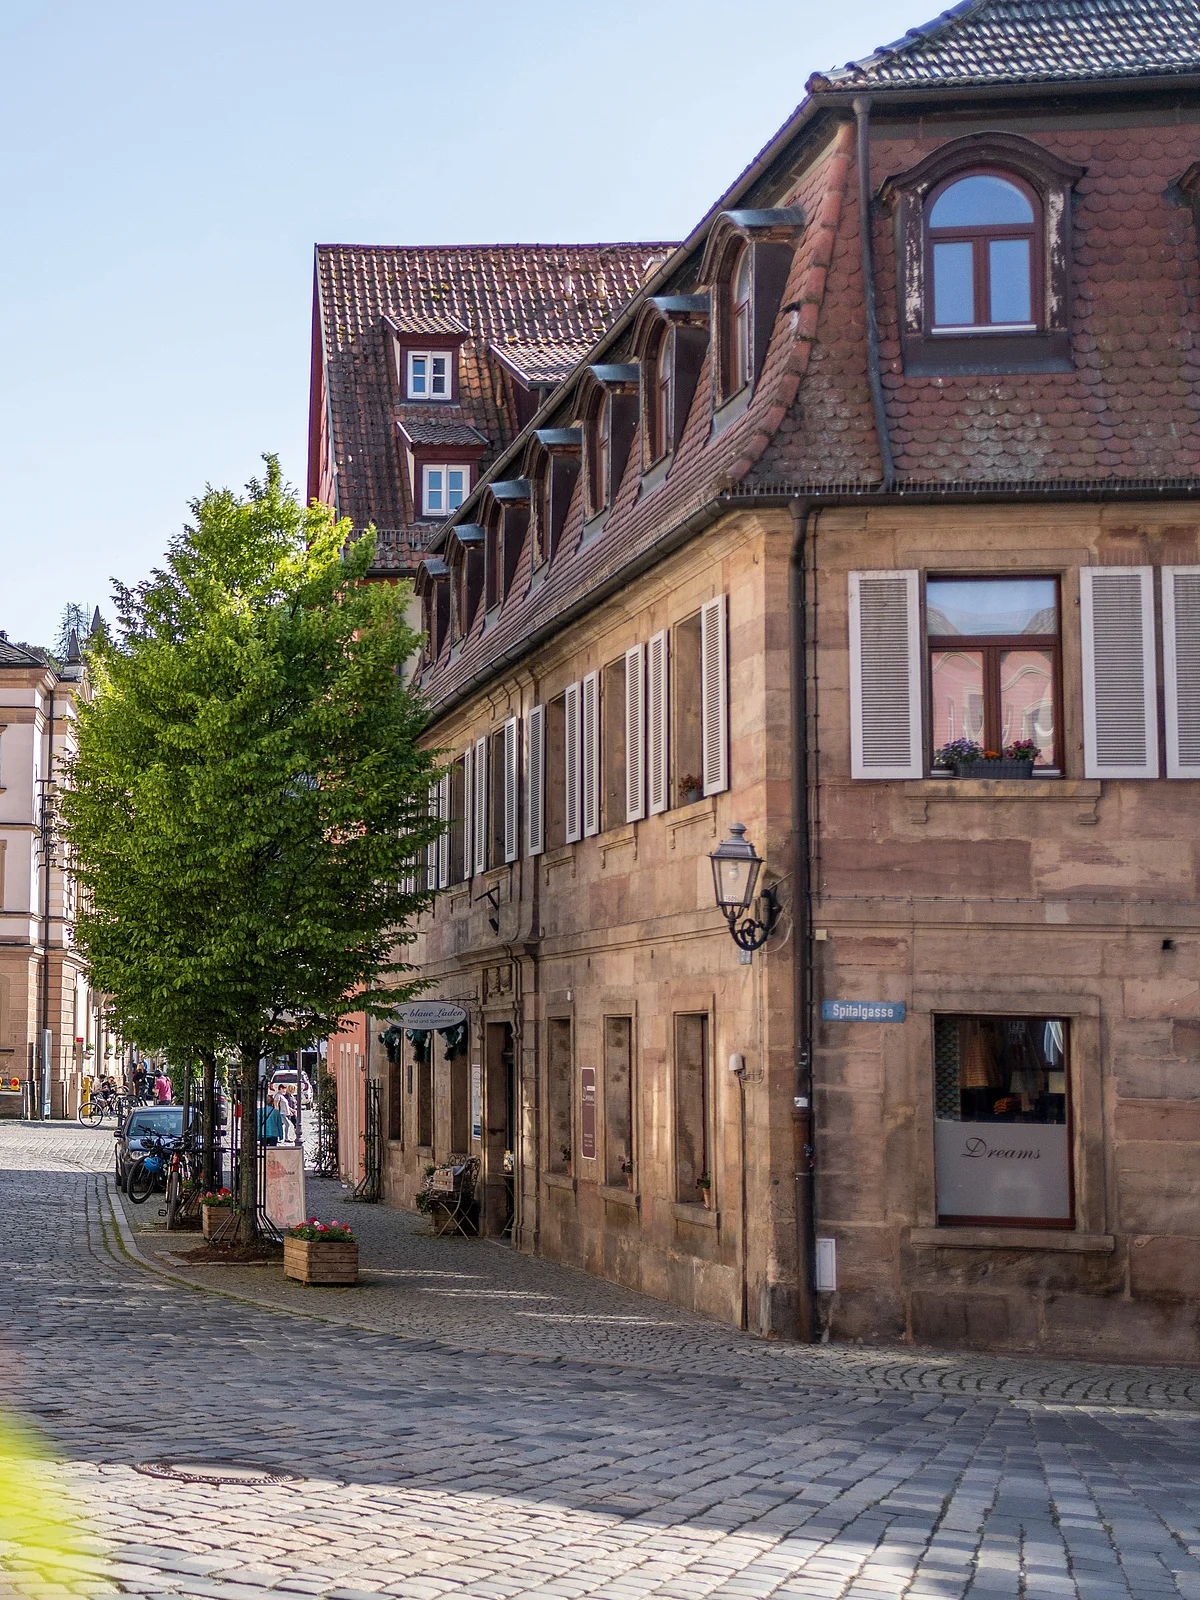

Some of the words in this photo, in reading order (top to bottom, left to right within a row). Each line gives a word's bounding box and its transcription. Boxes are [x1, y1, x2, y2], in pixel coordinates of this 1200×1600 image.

[409, 1008, 434, 1018] blaue
[435, 1008, 463, 1018] Laden
[833, 1003, 894, 1020] Spitalgasse
[960, 1137, 1040, 1160] Dreams
